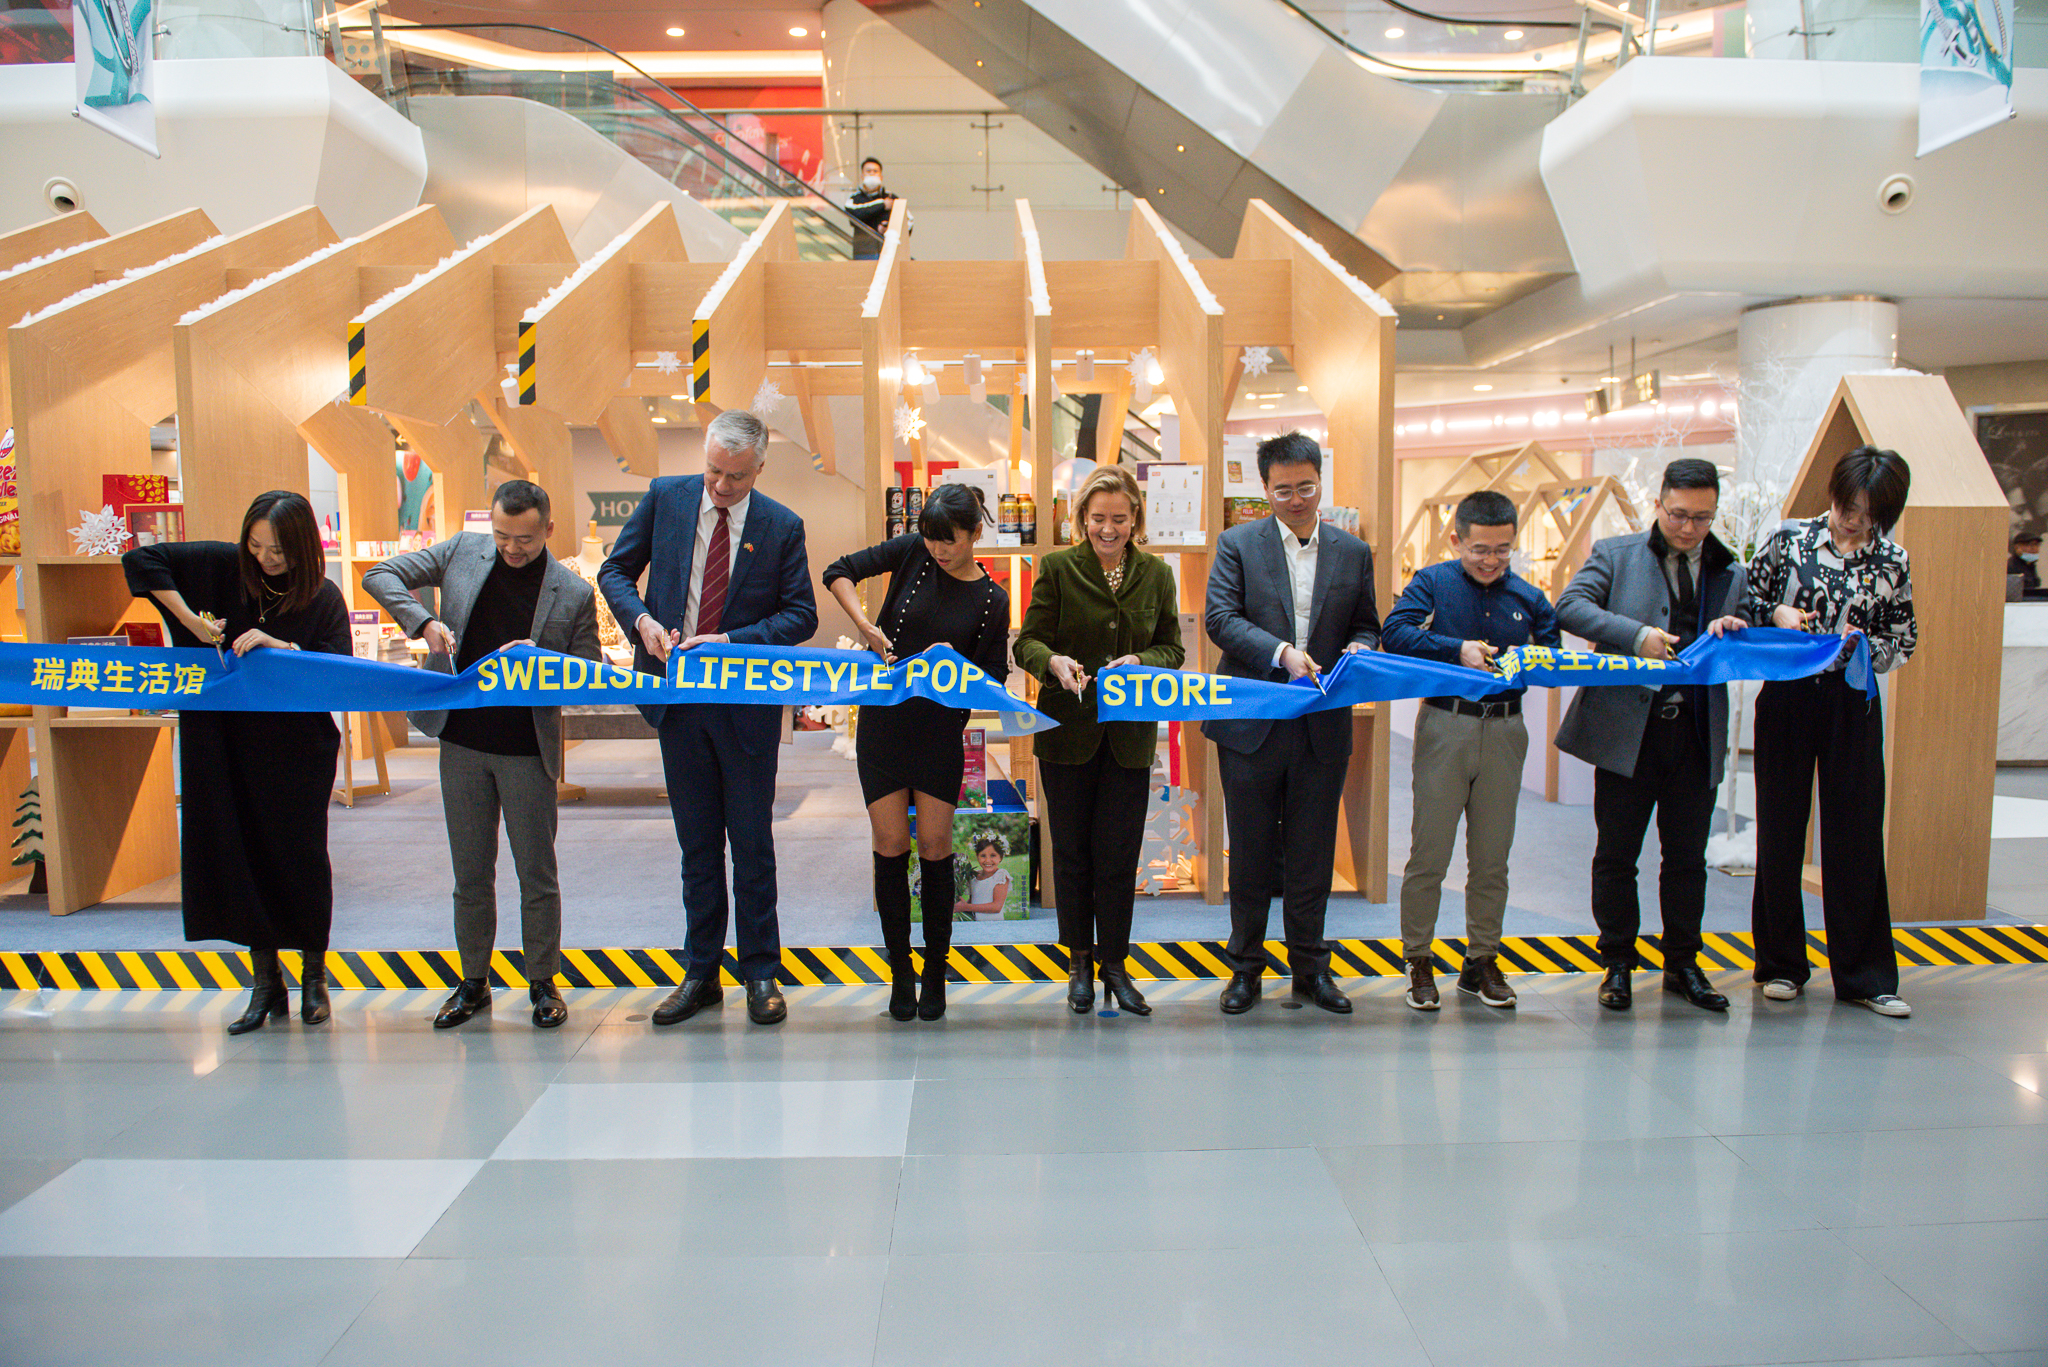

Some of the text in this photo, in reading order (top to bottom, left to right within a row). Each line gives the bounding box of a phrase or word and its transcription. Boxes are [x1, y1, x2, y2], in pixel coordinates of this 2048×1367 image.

[600, 500, 640, 518] HO
[31, 657, 207, 694] 瑞典生活馆
[477, 656, 661, 691] SWEDISH
[675, 656, 895, 692] LIFESTYLE
[1103, 673, 1233, 707] STORE
